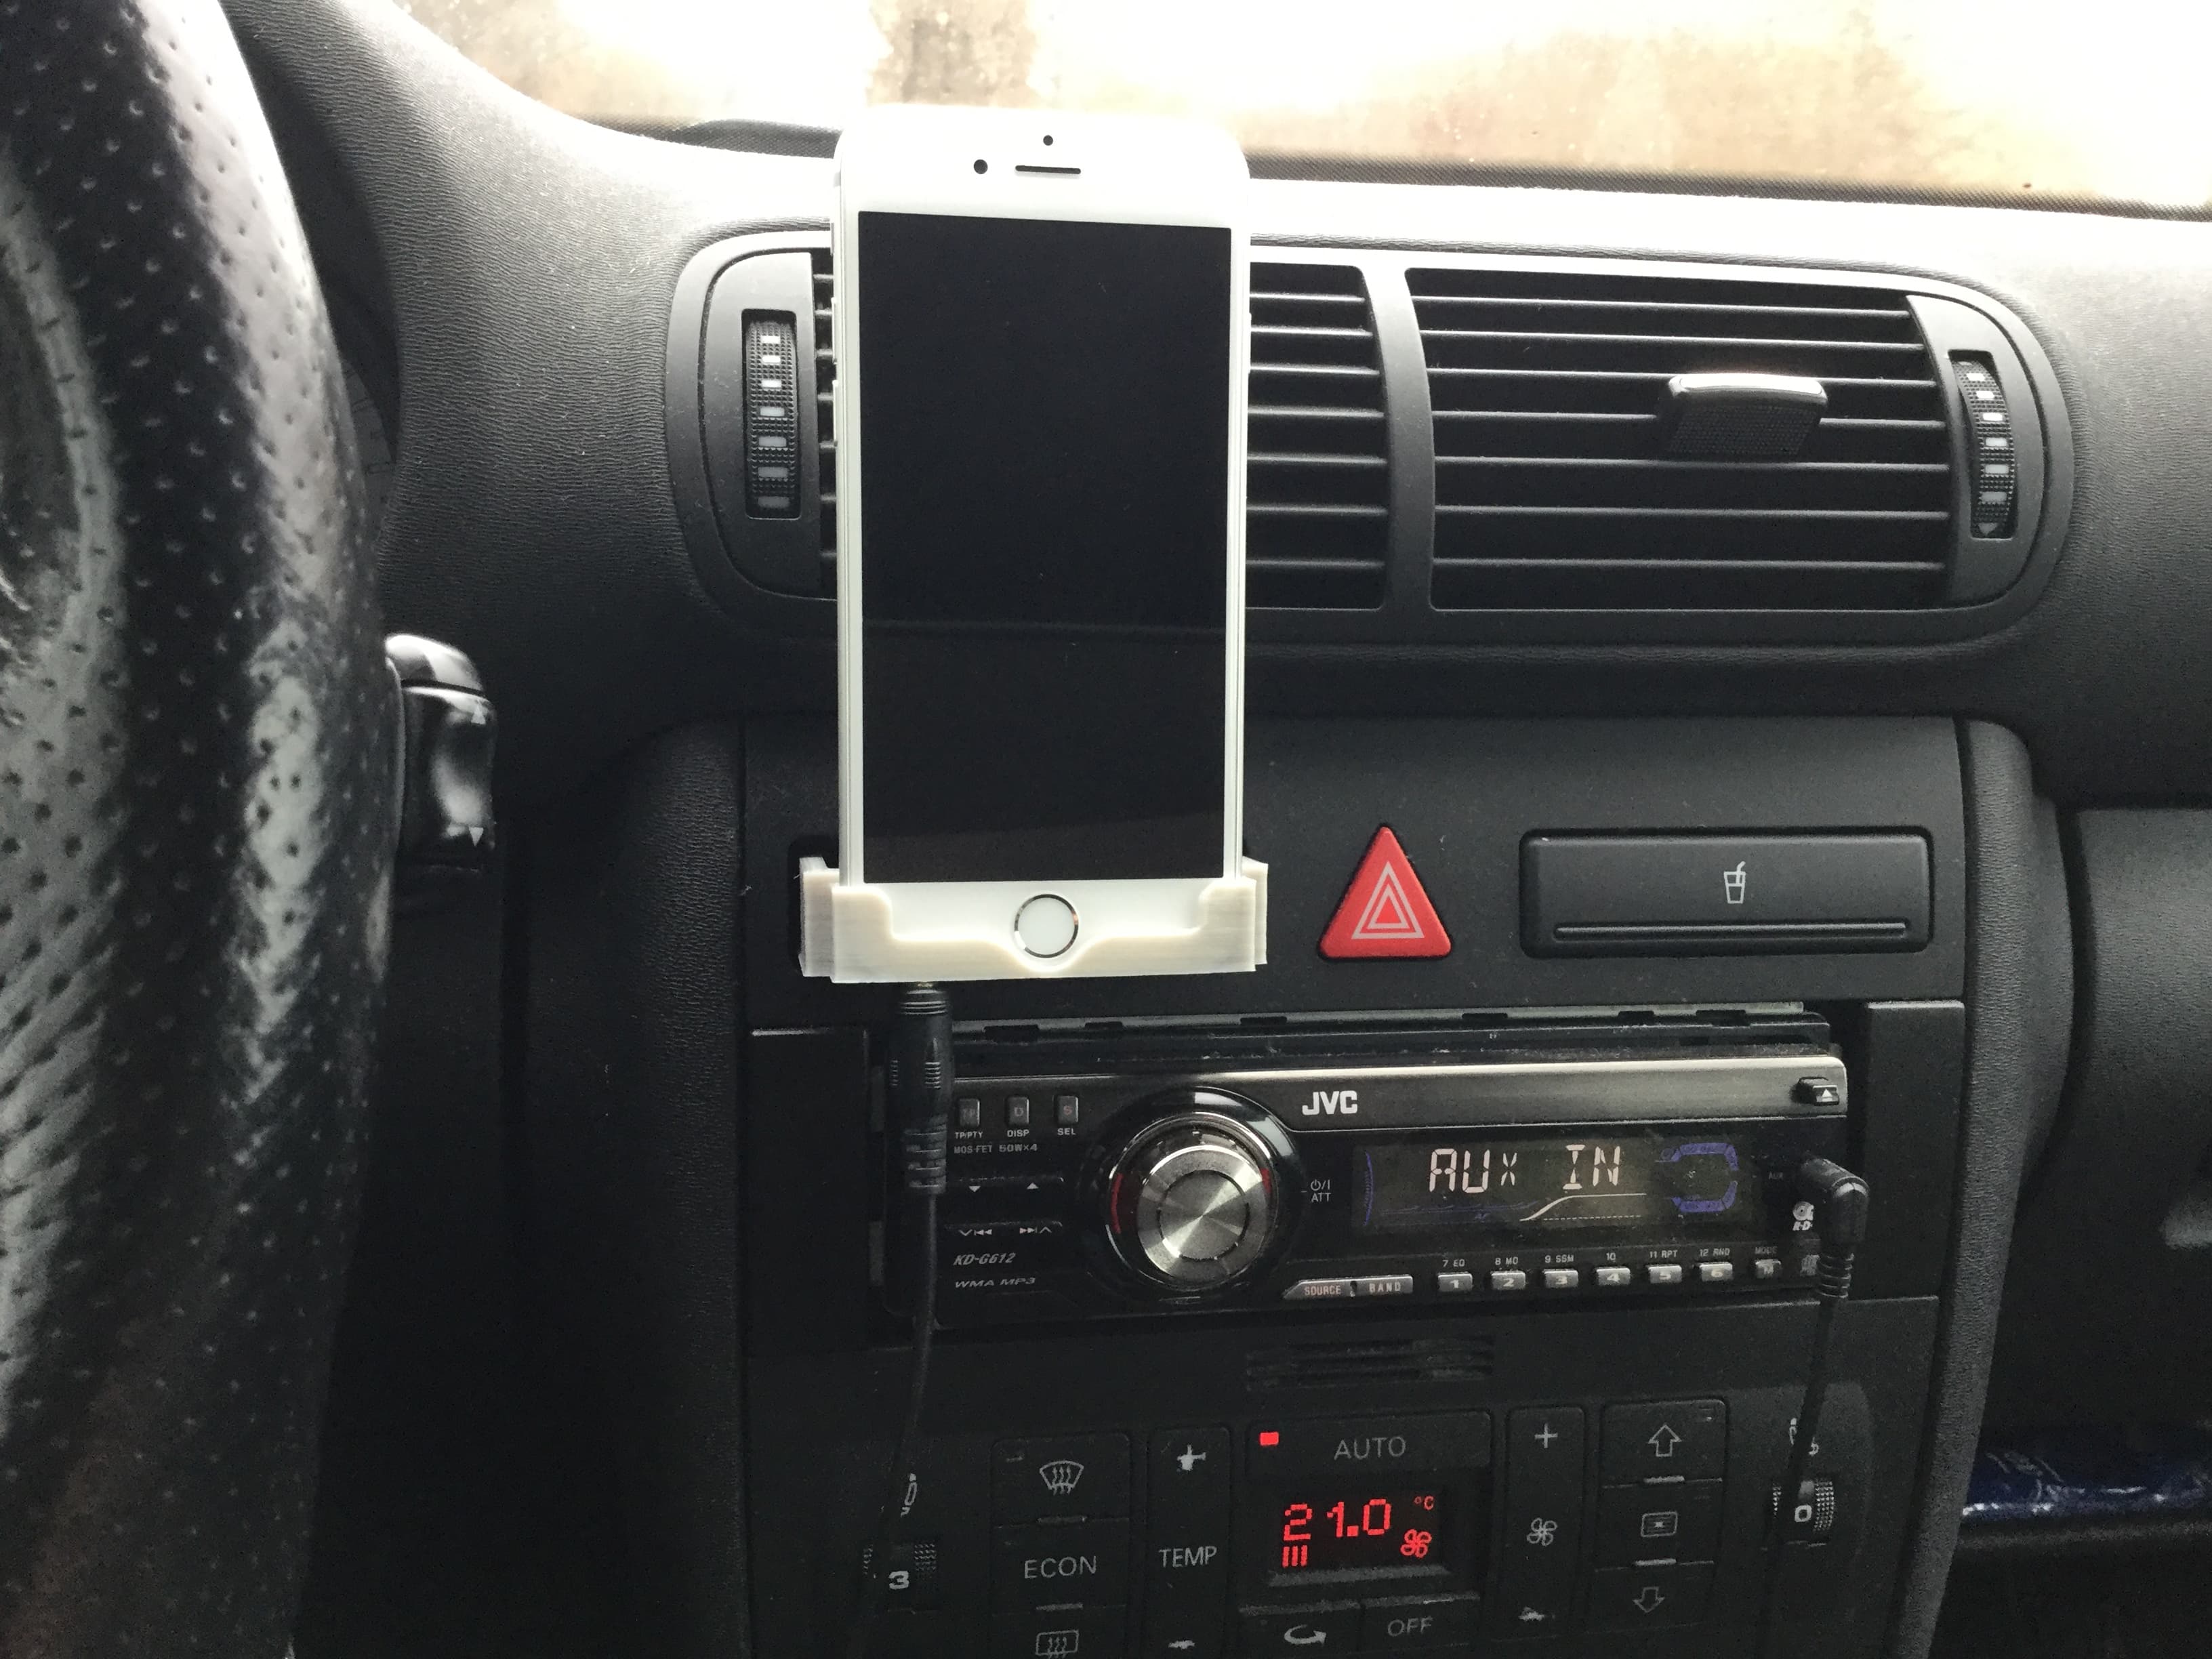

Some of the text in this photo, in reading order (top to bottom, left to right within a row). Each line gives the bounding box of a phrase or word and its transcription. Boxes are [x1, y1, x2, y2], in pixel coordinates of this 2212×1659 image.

[1302, 1090, 1357, 1115] JVC
[1006, 1128, 1030, 1138] DISP
[1057, 1127, 1076, 1136] SEL
[1562, 1144, 1620, 1190] IN
[1310, 1192, 1332, 1203] ATT
[1605, 1252, 1616, 1261] 10
[1649, 1249, 1678, 1258] 11 RPT
[1699, 1248, 1708, 1257] 12
[953, 1252, 1016, 1266] KD-G612
[1441, 1259, 1449, 1268] 7
[1494, 1257, 1502, 1266] 8
[1544, 1254, 1574, 1264] 9 SSM
[954, 1277, 1036, 1288] WMA MP3
[1450, 1279, 1459, 1288] 1
[1503, 1278, 1515, 1287] 2
[1557, 1276, 1568, 1285] 3
[1607, 1274, 1620, 1283] 4
[1304, 1285, 1341, 1296] SOURCE
[1369, 1282, 1401, 1292] BAND
[1333, 1436, 1406, 1460] AUTO
[1282, 1498, 1393, 1542] 21.0
[1158, 1545, 1217, 1568] TEMP
[1023, 1555, 1097, 1579] ECON
[888, 1570, 909, 1591] 3
[1387, 1616, 1434, 1637] OFF
